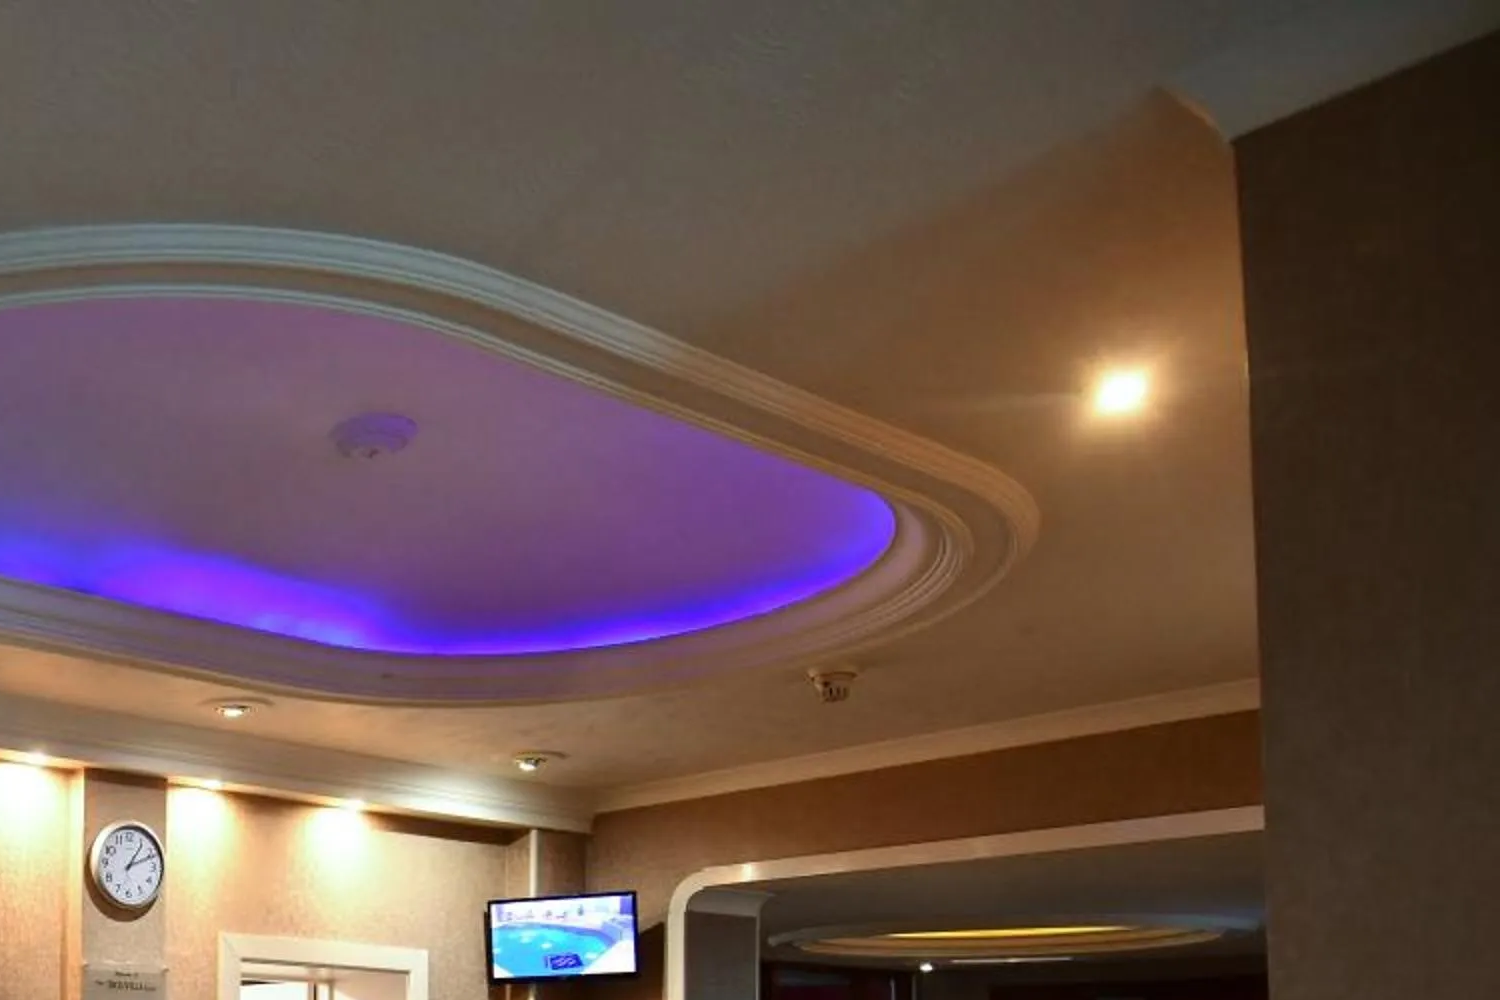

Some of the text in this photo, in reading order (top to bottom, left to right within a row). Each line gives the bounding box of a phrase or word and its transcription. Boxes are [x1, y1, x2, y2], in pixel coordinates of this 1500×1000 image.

[115, 834, 123, 845] 11
[105, 846, 117, 857] 10
[101, 857, 109, 869] 9
[149, 862, 157, 873] 3
[106, 872, 113, 883] 8
[146, 876, 153, 885] 4
[115, 883, 122, 893] 7
[125, 888, 133, 898] 6
